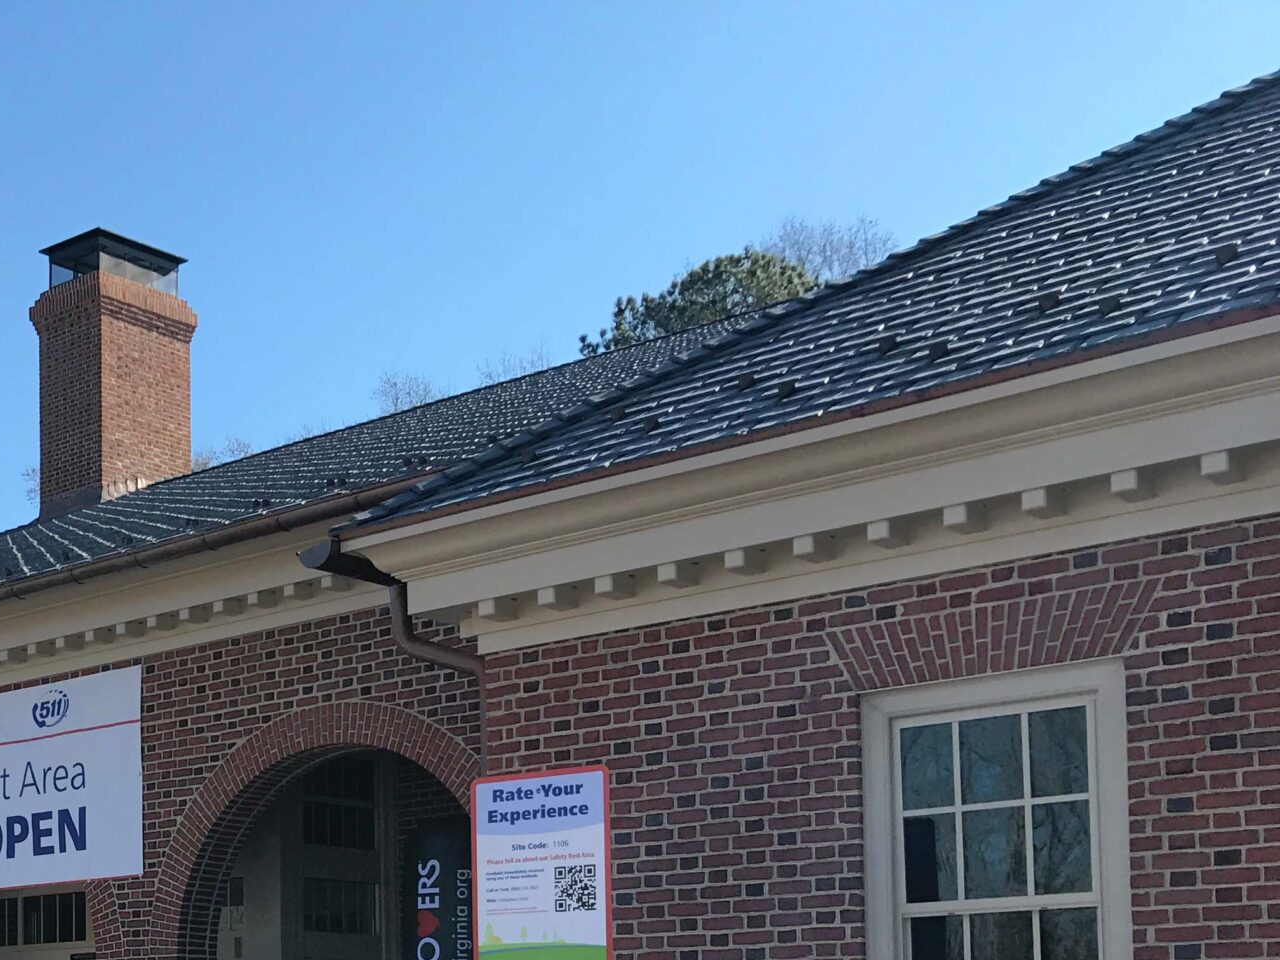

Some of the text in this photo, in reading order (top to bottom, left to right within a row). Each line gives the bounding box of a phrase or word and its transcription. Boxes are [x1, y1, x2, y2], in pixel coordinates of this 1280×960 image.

[39, 698, 62, 719] 511
[19, 761, 86, 797] Area
[492, 784, 583, 803] Rate Your
[488, 804, 589, 825] Experience
[512, 844, 526, 852] Site
[528, 842, 549, 851] Code:
[549, 853, 567, 861] Safety
